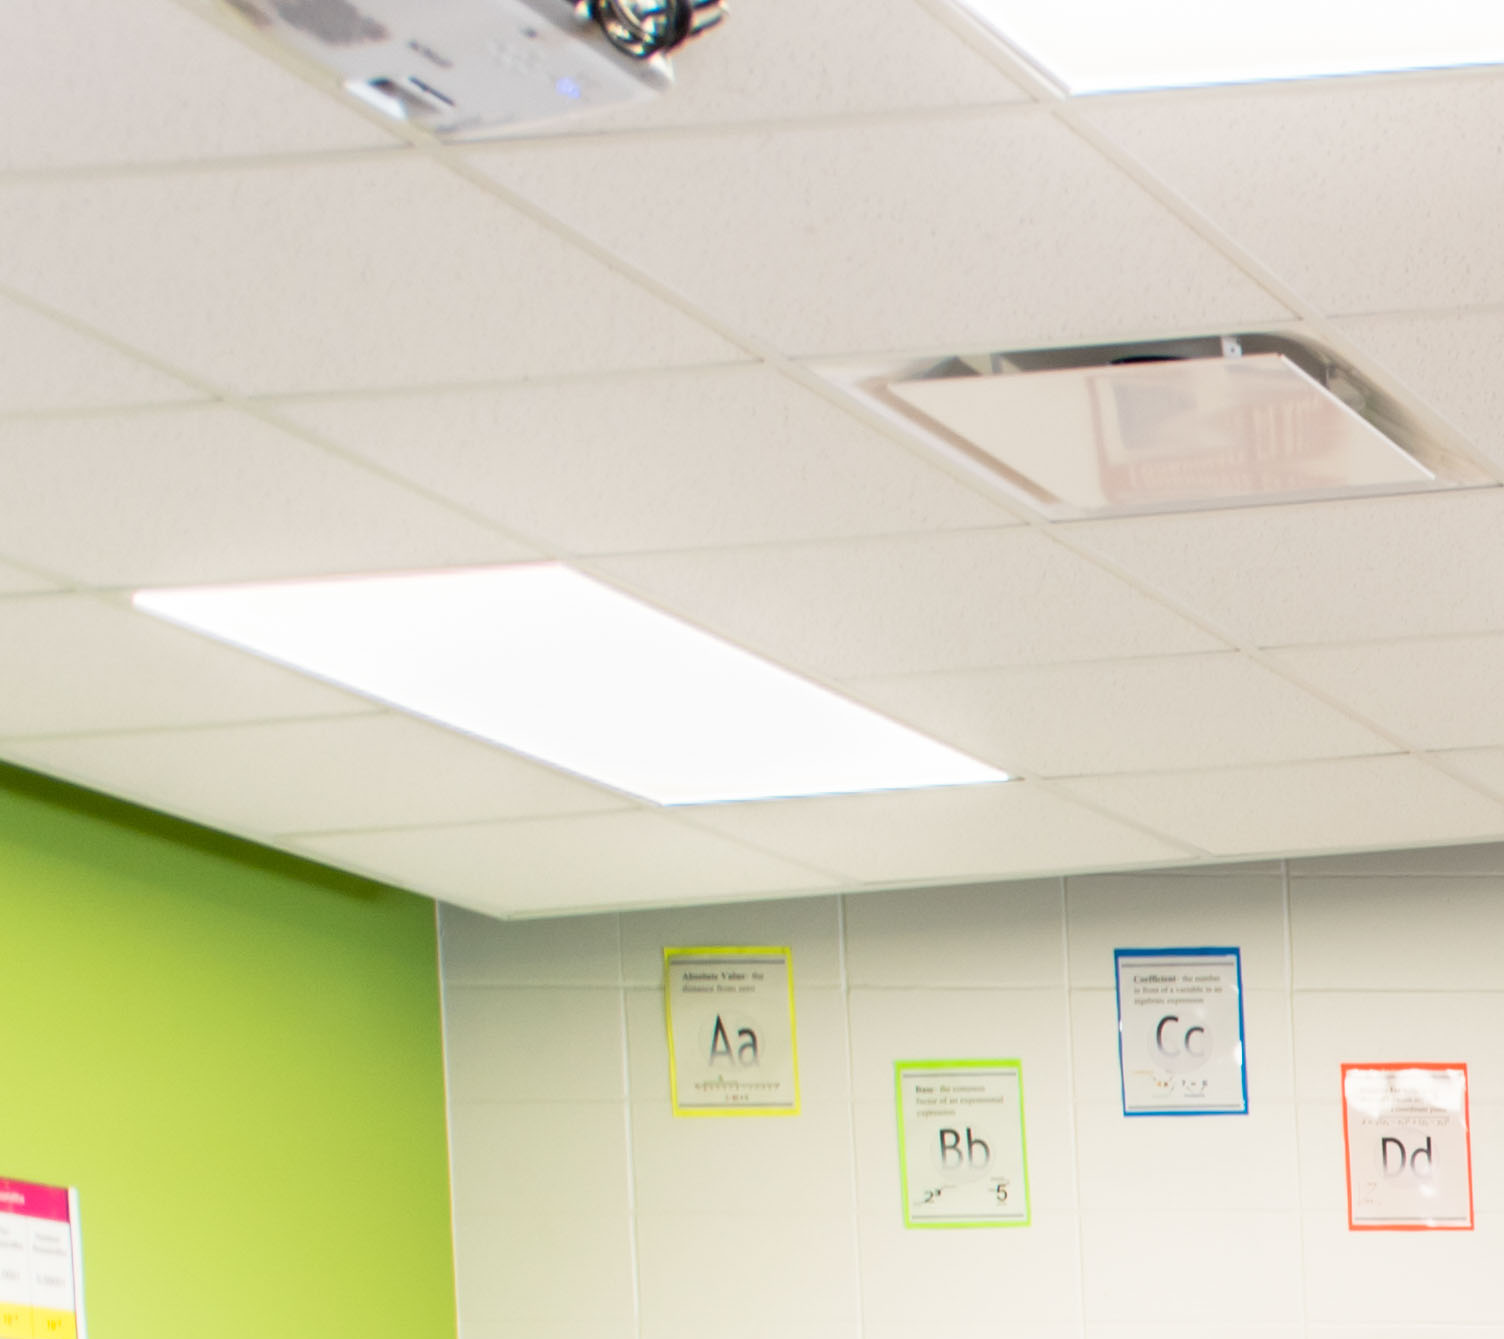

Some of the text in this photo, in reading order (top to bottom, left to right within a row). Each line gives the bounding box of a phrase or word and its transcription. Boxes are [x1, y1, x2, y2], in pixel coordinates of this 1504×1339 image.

[708, 1013, 760, 1068] Aa
[1155, 1014, 1205, 1059] Cc
[938, 1127, 990, 1172] Bb
[1380, 1135, 1433, 1179] Dd
